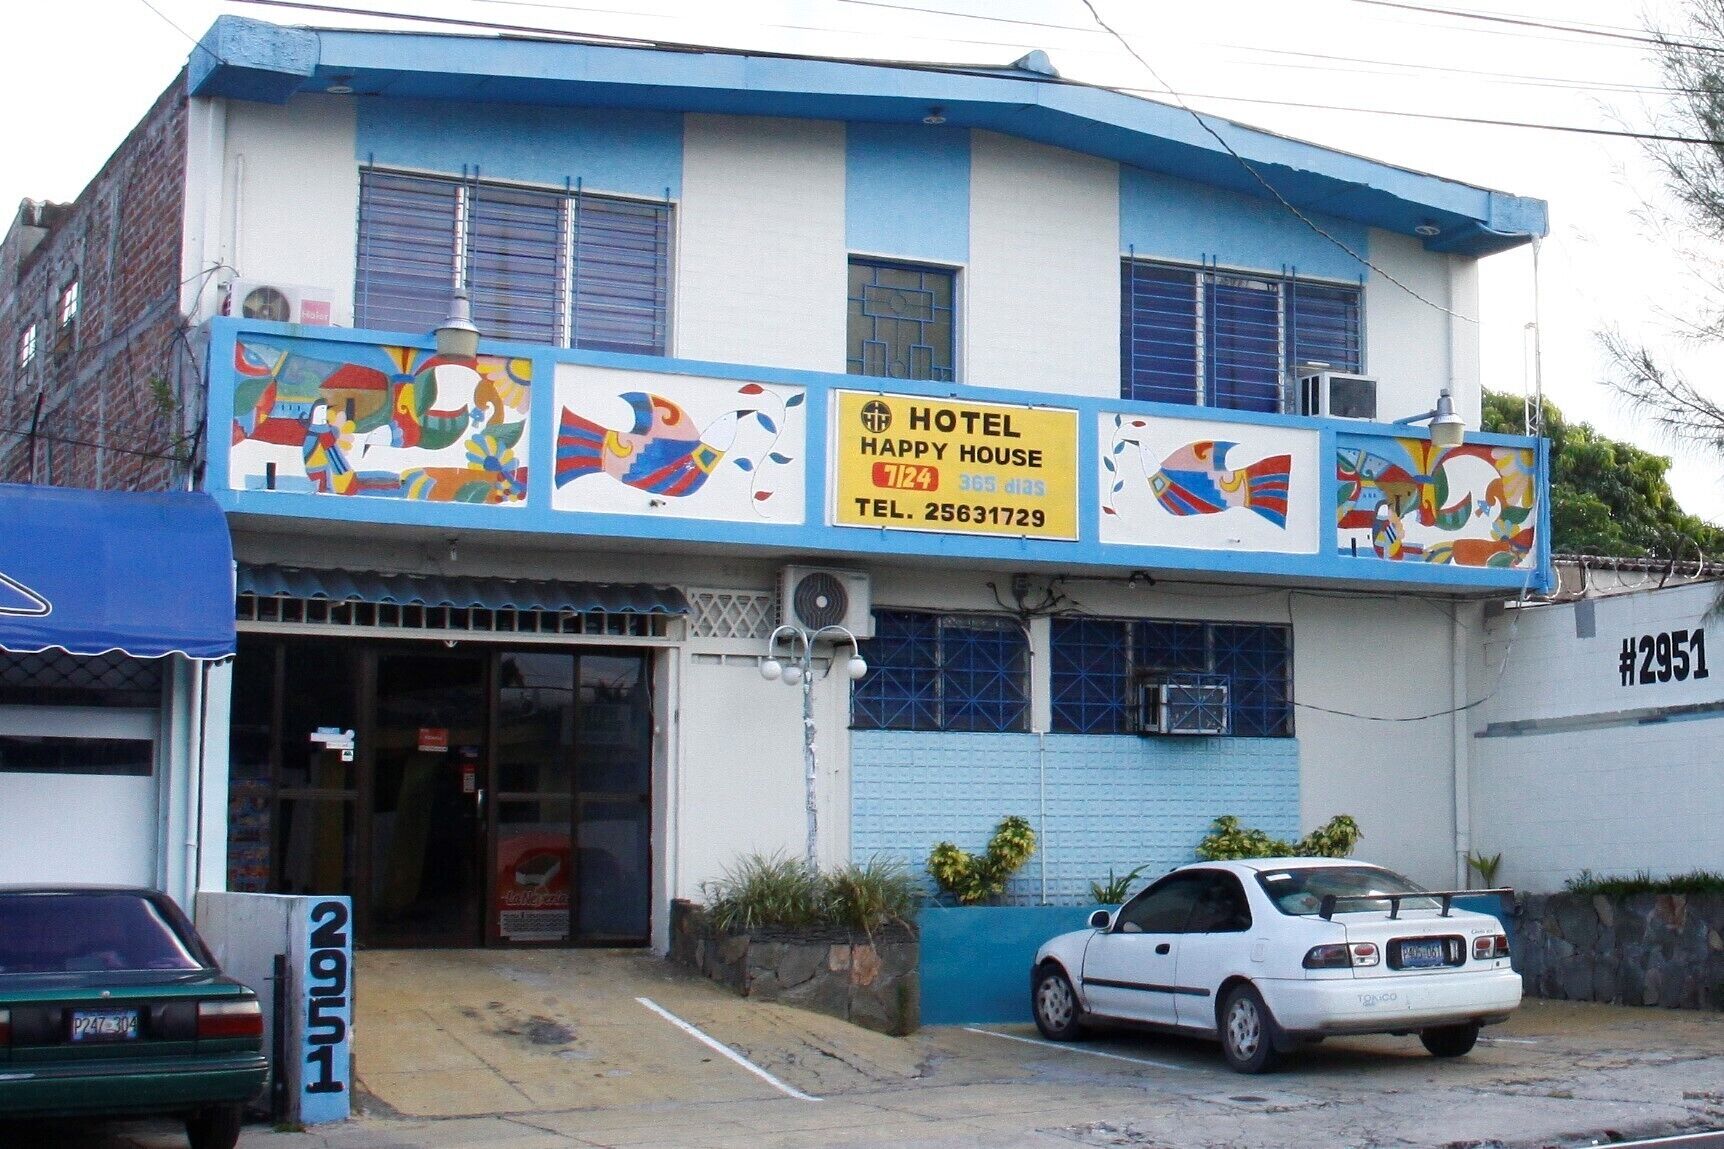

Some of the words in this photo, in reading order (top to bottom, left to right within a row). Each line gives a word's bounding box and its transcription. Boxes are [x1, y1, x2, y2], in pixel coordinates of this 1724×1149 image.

[910, 407, 1021, 438] HOTEL
[861, 437, 948, 459] HAPPY
[960, 445, 1043, 468] HOUSE
[959, 474, 996, 493] 365
[855, 499, 913, 519] TEL.
[925, 502, 1046, 527] 25631729
[1619, 628, 1709, 686] #2951
[306, 901, 348, 1093] 2951
